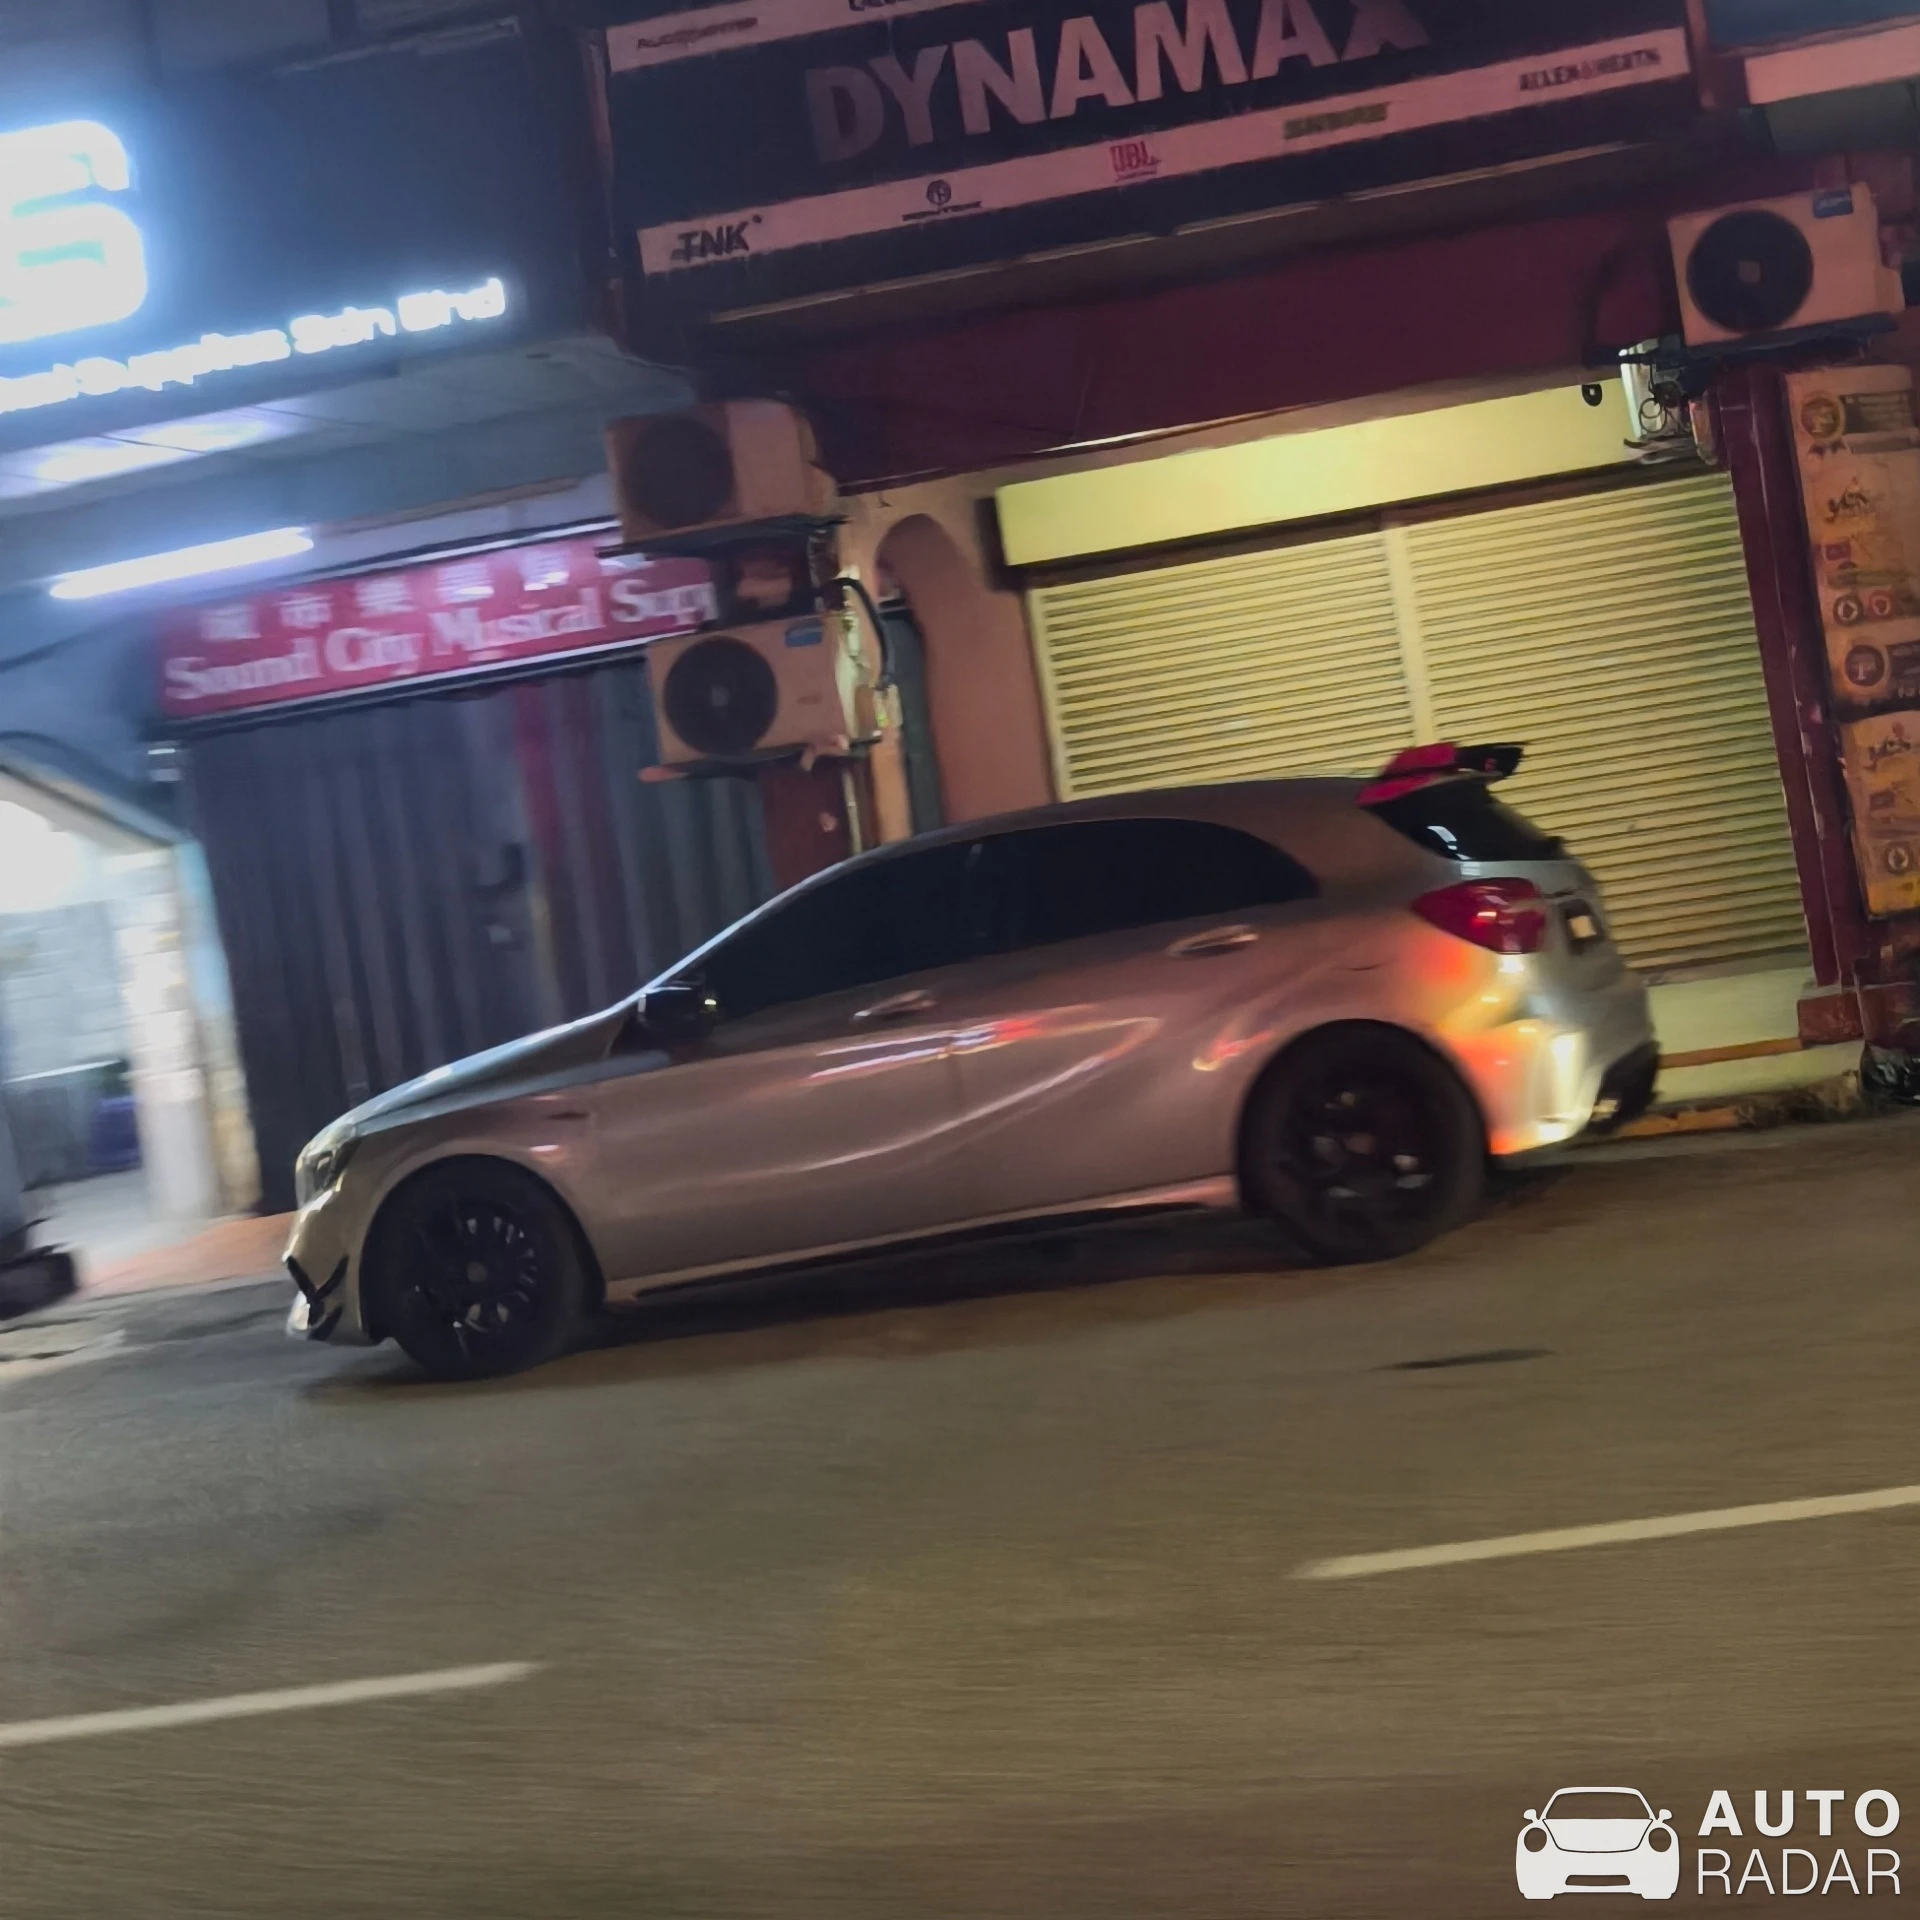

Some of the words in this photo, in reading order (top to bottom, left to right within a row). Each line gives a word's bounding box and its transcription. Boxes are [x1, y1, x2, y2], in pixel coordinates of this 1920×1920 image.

[804, 0, 1430, 164] DYNAMAX
[165, 636, 325, 700] Sound
[427, 587, 606, 656] Musical
